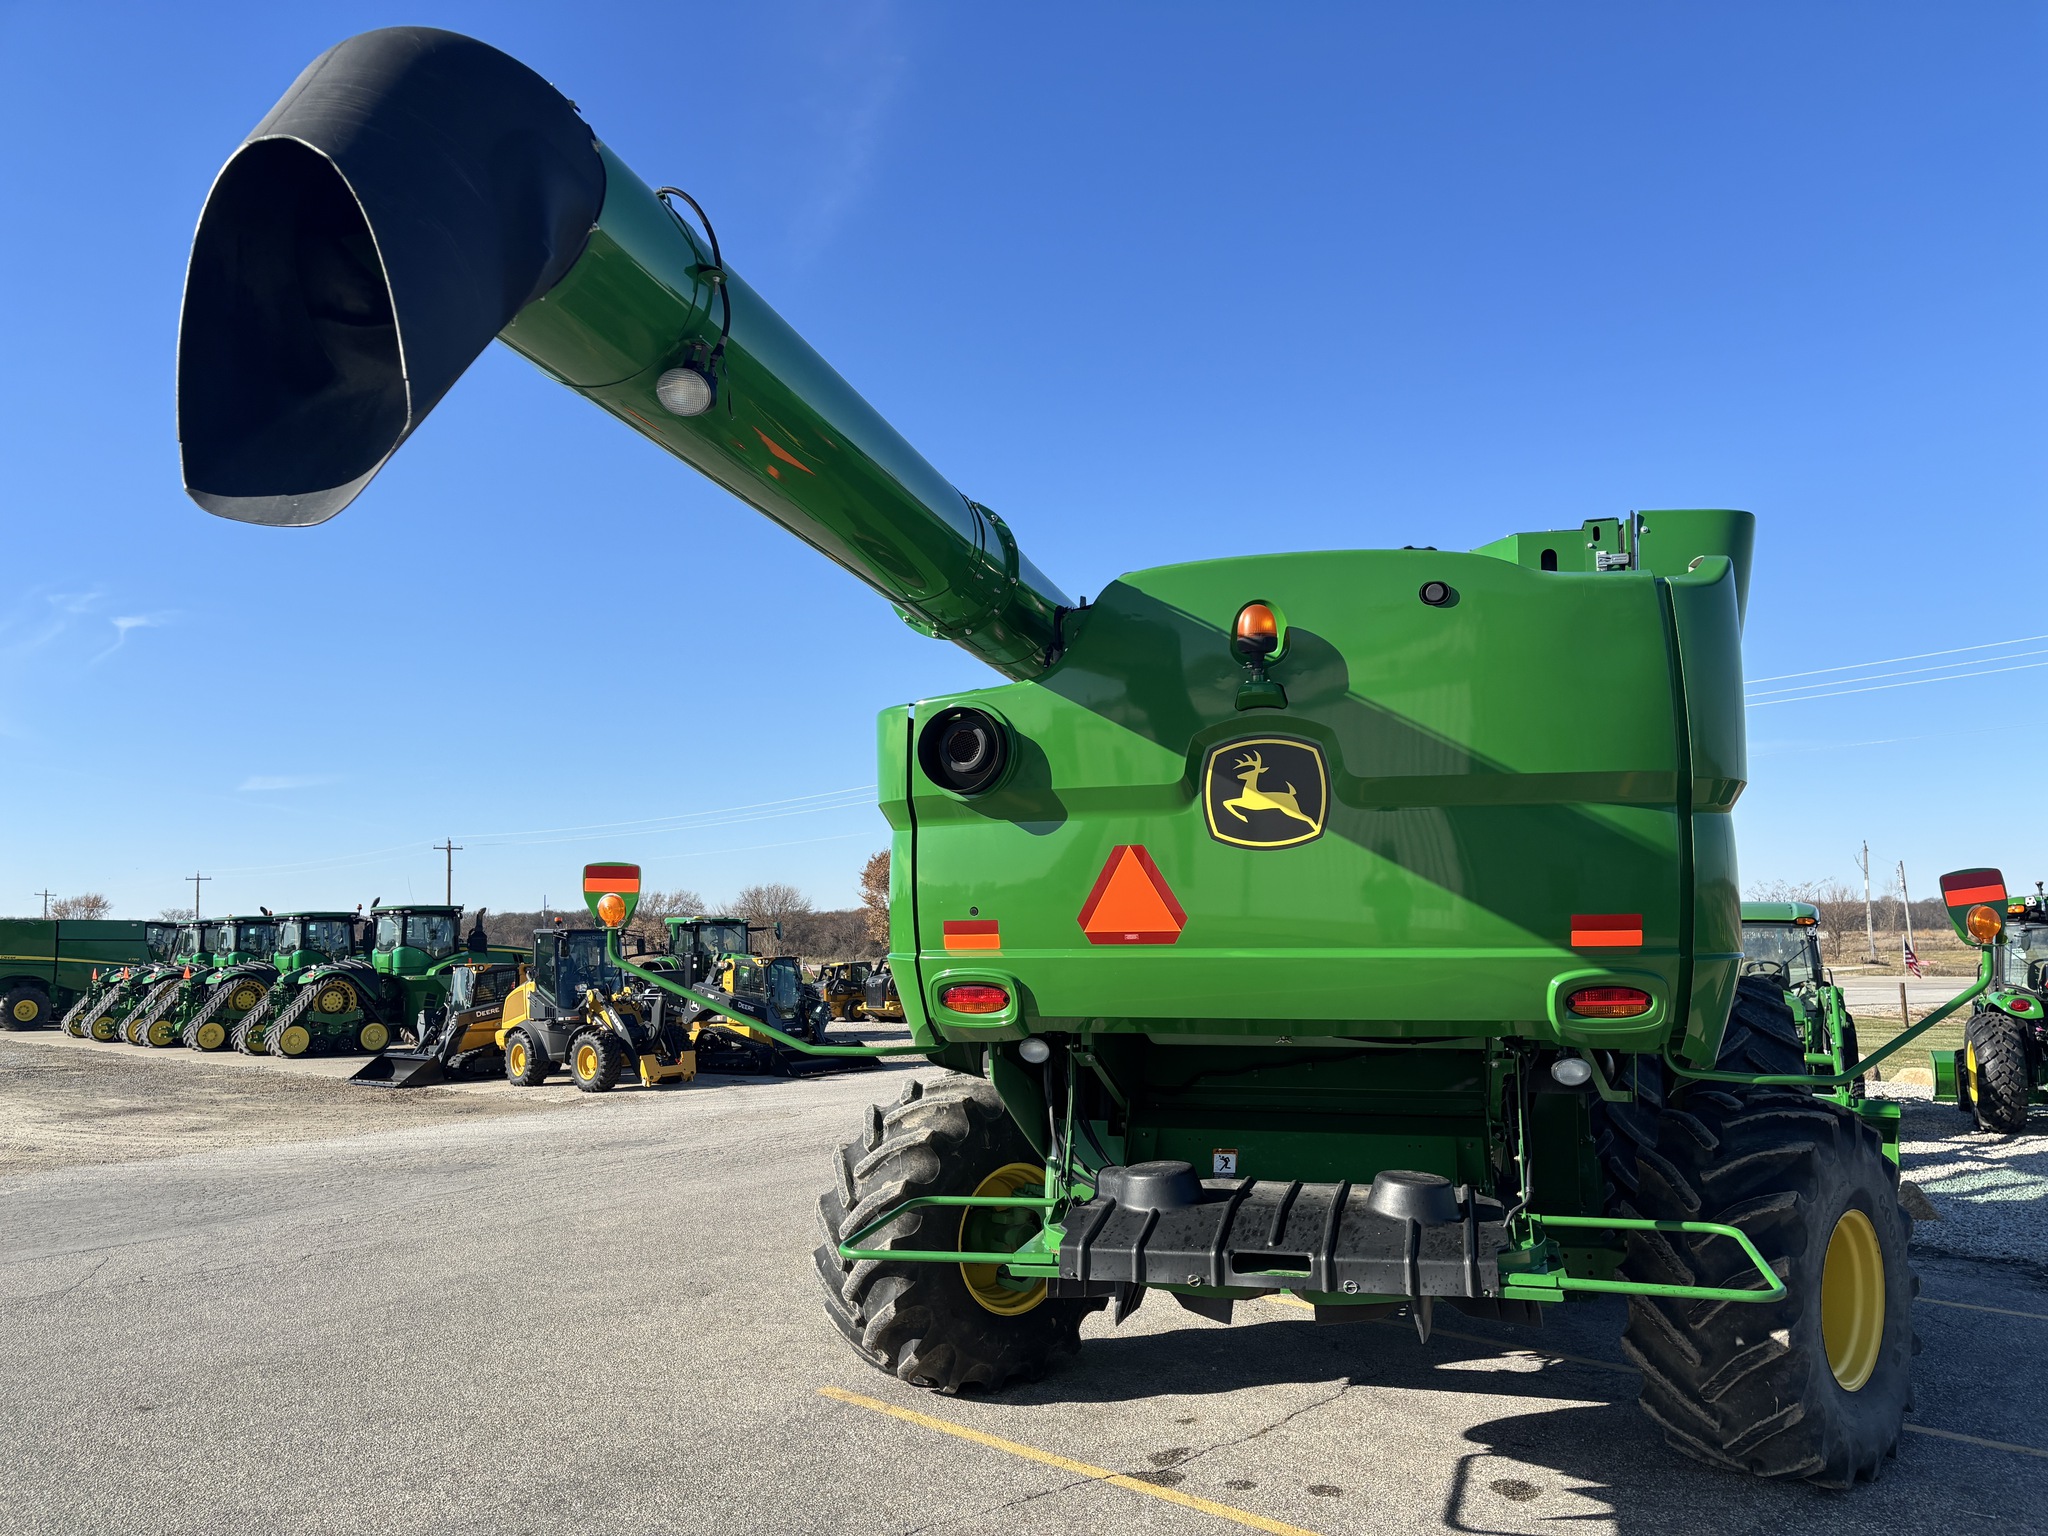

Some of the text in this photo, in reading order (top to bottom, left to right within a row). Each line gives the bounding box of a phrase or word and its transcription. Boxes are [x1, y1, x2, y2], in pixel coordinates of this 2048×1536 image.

[475, 1007, 500, 1018] DEERE
[737, 1002, 755, 1012] DEERE
[608, 1008, 624, 1032] DEERE
